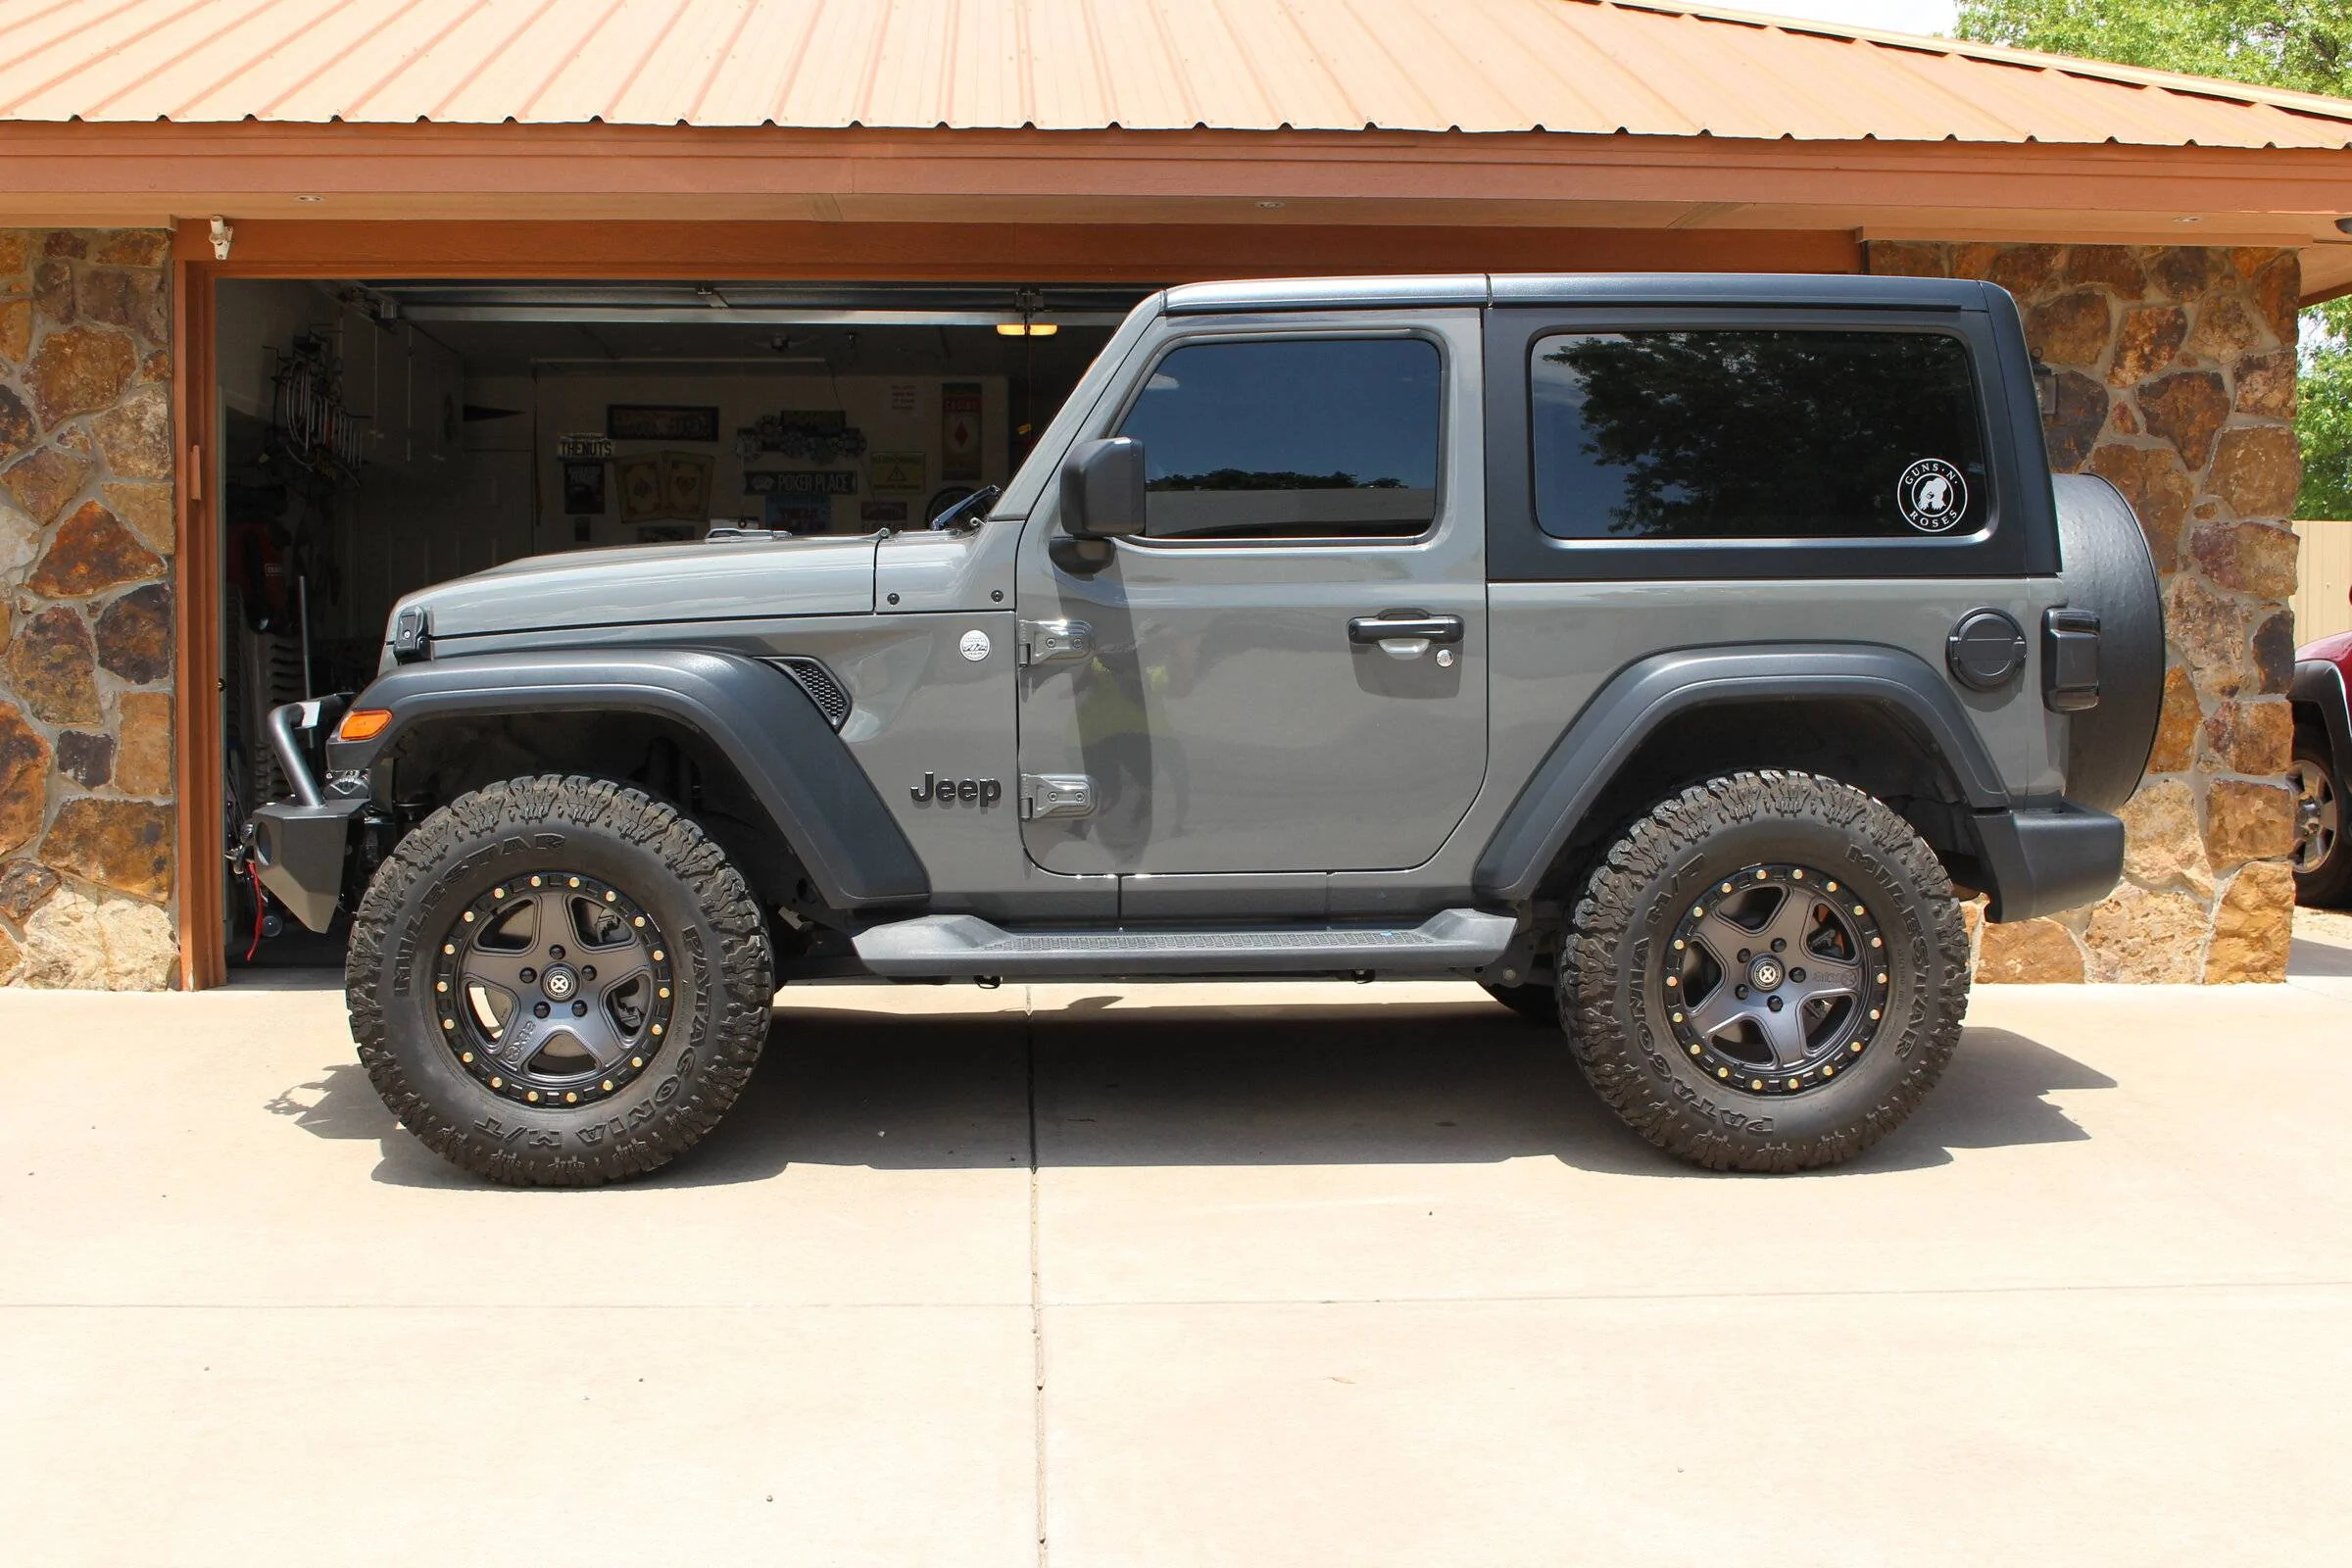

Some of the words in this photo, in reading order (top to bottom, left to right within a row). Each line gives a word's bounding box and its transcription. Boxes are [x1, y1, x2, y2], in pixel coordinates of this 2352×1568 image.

[778, 473, 812, 493] POKER
[815, 473, 849, 493] PLACE
[1909, 510, 1957, 528] ROSES
[910, 771, 1002, 808] Jeep
[393, 832, 566, 998] MILESTAR
[1644, 853, 1708, 929] M/T
[1845, 842, 1929, 1061] MILESTAR
[574, 924, 710, 1149] PATAGONIA
[1629, 937, 1775, 1138] PATAGONIA
[473, 1117, 564, 1150] M/T
